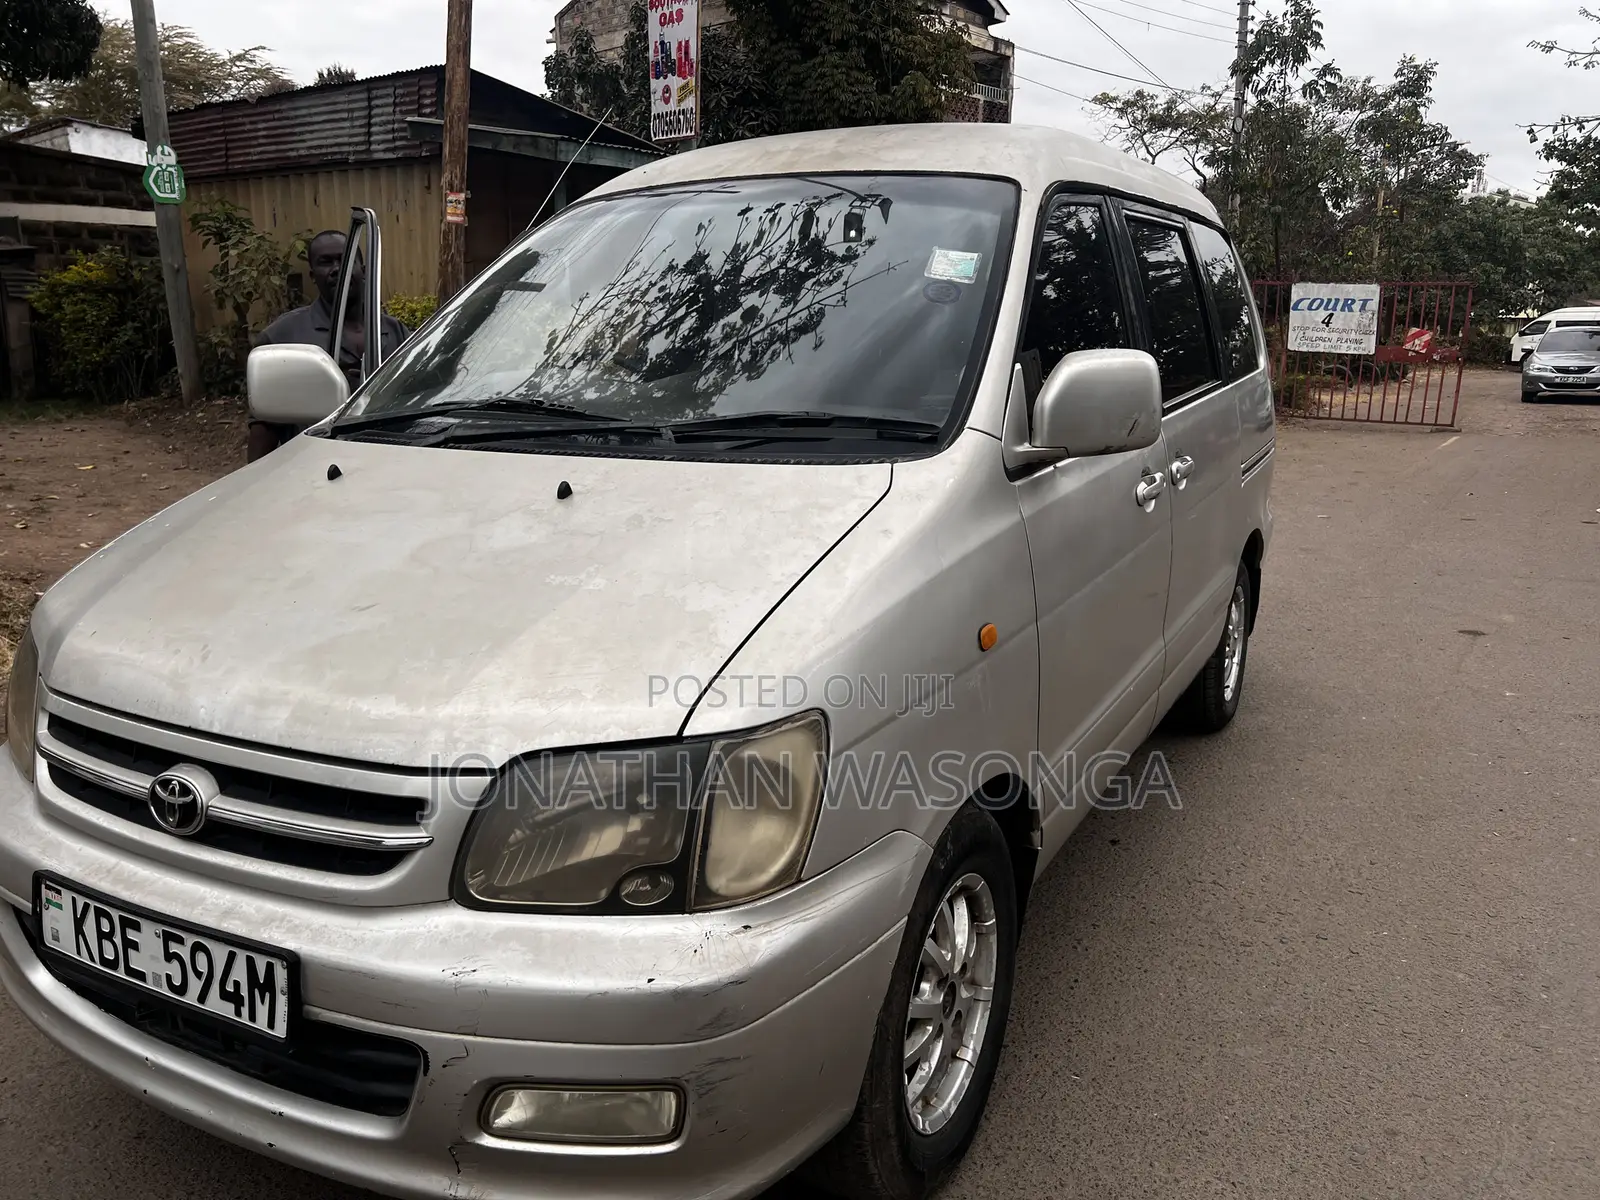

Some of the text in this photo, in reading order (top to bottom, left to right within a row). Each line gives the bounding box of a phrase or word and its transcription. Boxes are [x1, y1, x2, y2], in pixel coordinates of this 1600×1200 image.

[659, 8, 684, 27] GAS
[1291, 298, 1374, 312] COURT
[1321, 312, 1335, 327] 4
[1326, 327, 1358, 335] SECURITY
[1297, 342, 1320, 350] SPEED
[1299, 335, 1364, 345] CHILDREN PLAYING
[72, 895, 147, 983] KBE
[162, 928, 277, 1031] 594M
